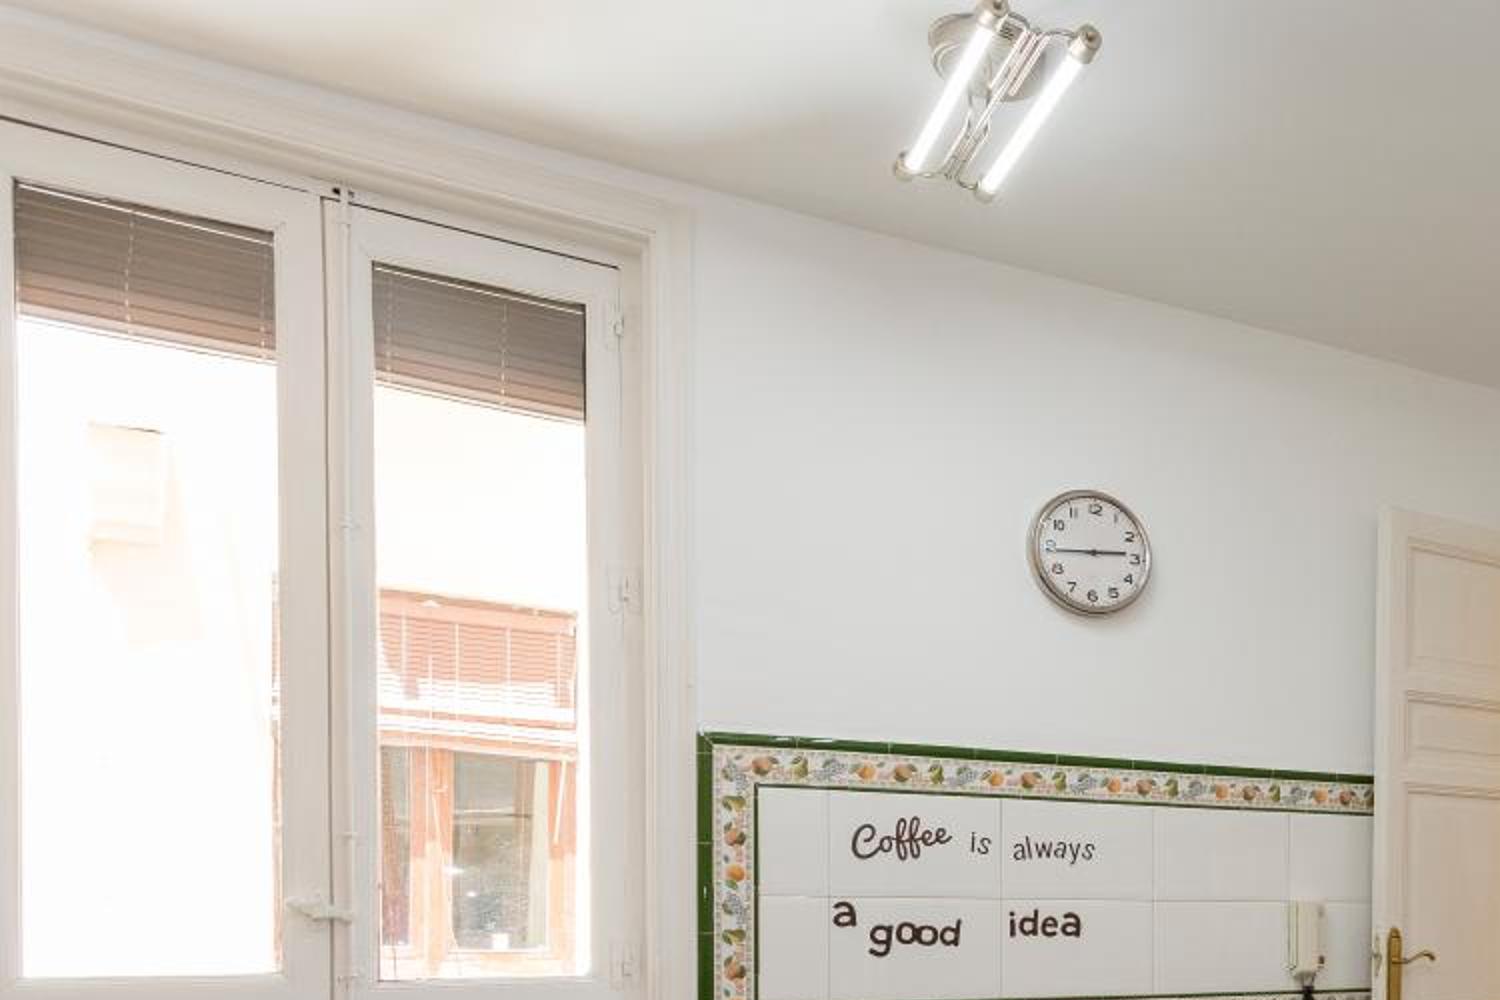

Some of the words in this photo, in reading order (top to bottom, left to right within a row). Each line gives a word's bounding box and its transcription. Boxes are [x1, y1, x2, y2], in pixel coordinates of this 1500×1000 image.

[1089, 503, 1103, 516] 12
[1053, 519, 1065, 531] 10
[1124, 531, 1135, 543] 2
[1129, 553, 1140, 566] 3
[1124, 573, 1133, 585] 4
[1067, 581, 1077, 593] 7
[1108, 586, 1120, 599] 5
[1087, 589, 1099, 602] 6
[851, 816, 952, 860] Coffee
[970, 832, 992, 854] is
[1013, 836, 1096, 864] always
[833, 901, 857, 927] a
[868, 919, 962, 957] good
[1008, 909, 1081, 937] idea
